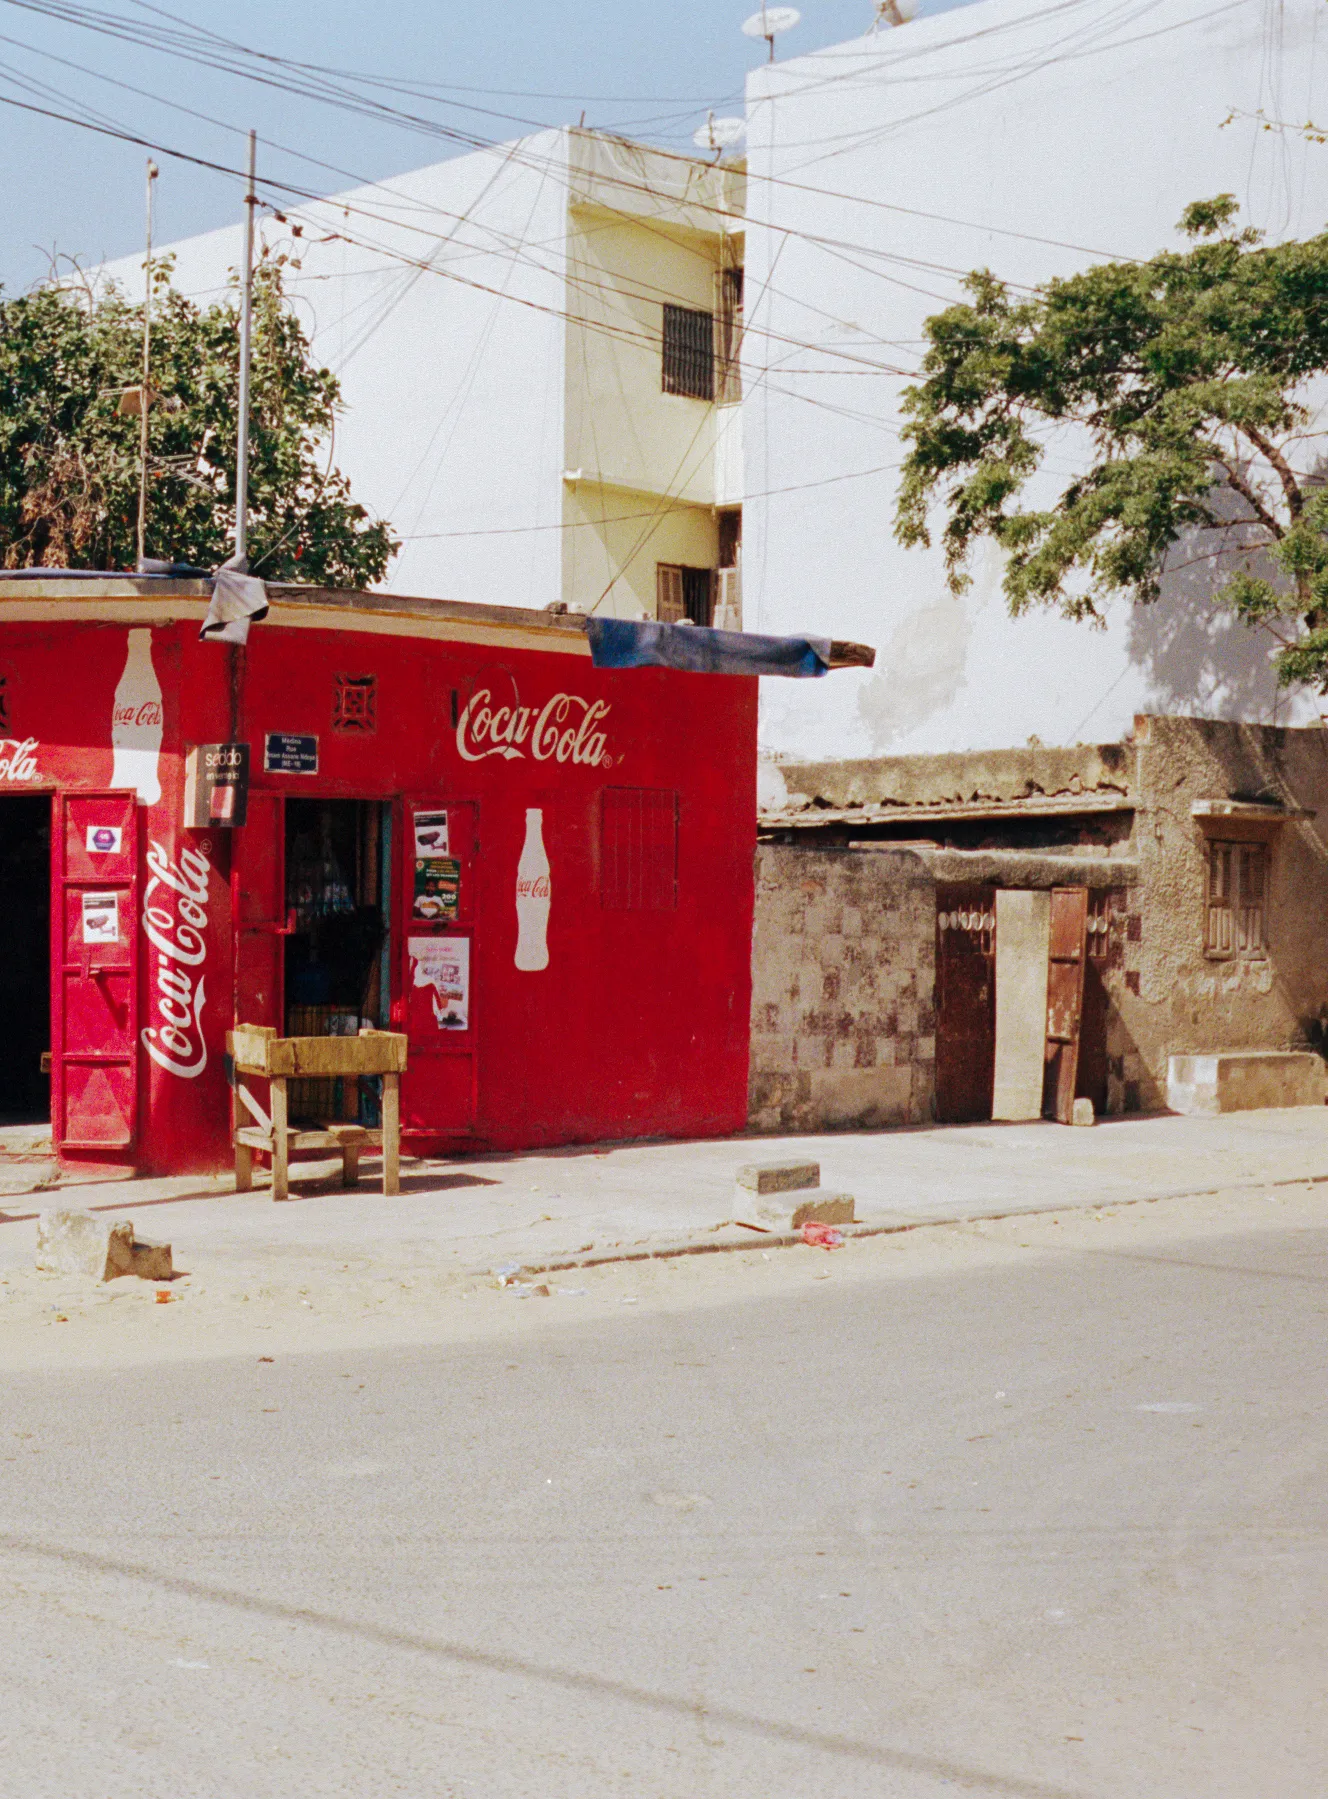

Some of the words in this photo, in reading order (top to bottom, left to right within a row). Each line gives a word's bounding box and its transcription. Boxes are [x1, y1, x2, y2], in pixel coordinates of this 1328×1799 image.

[205, 747, 242, 767] seddo
[456, 689, 612, 767] Coca-Cola
[140, 839, 211, 1079] Coca-Cola
